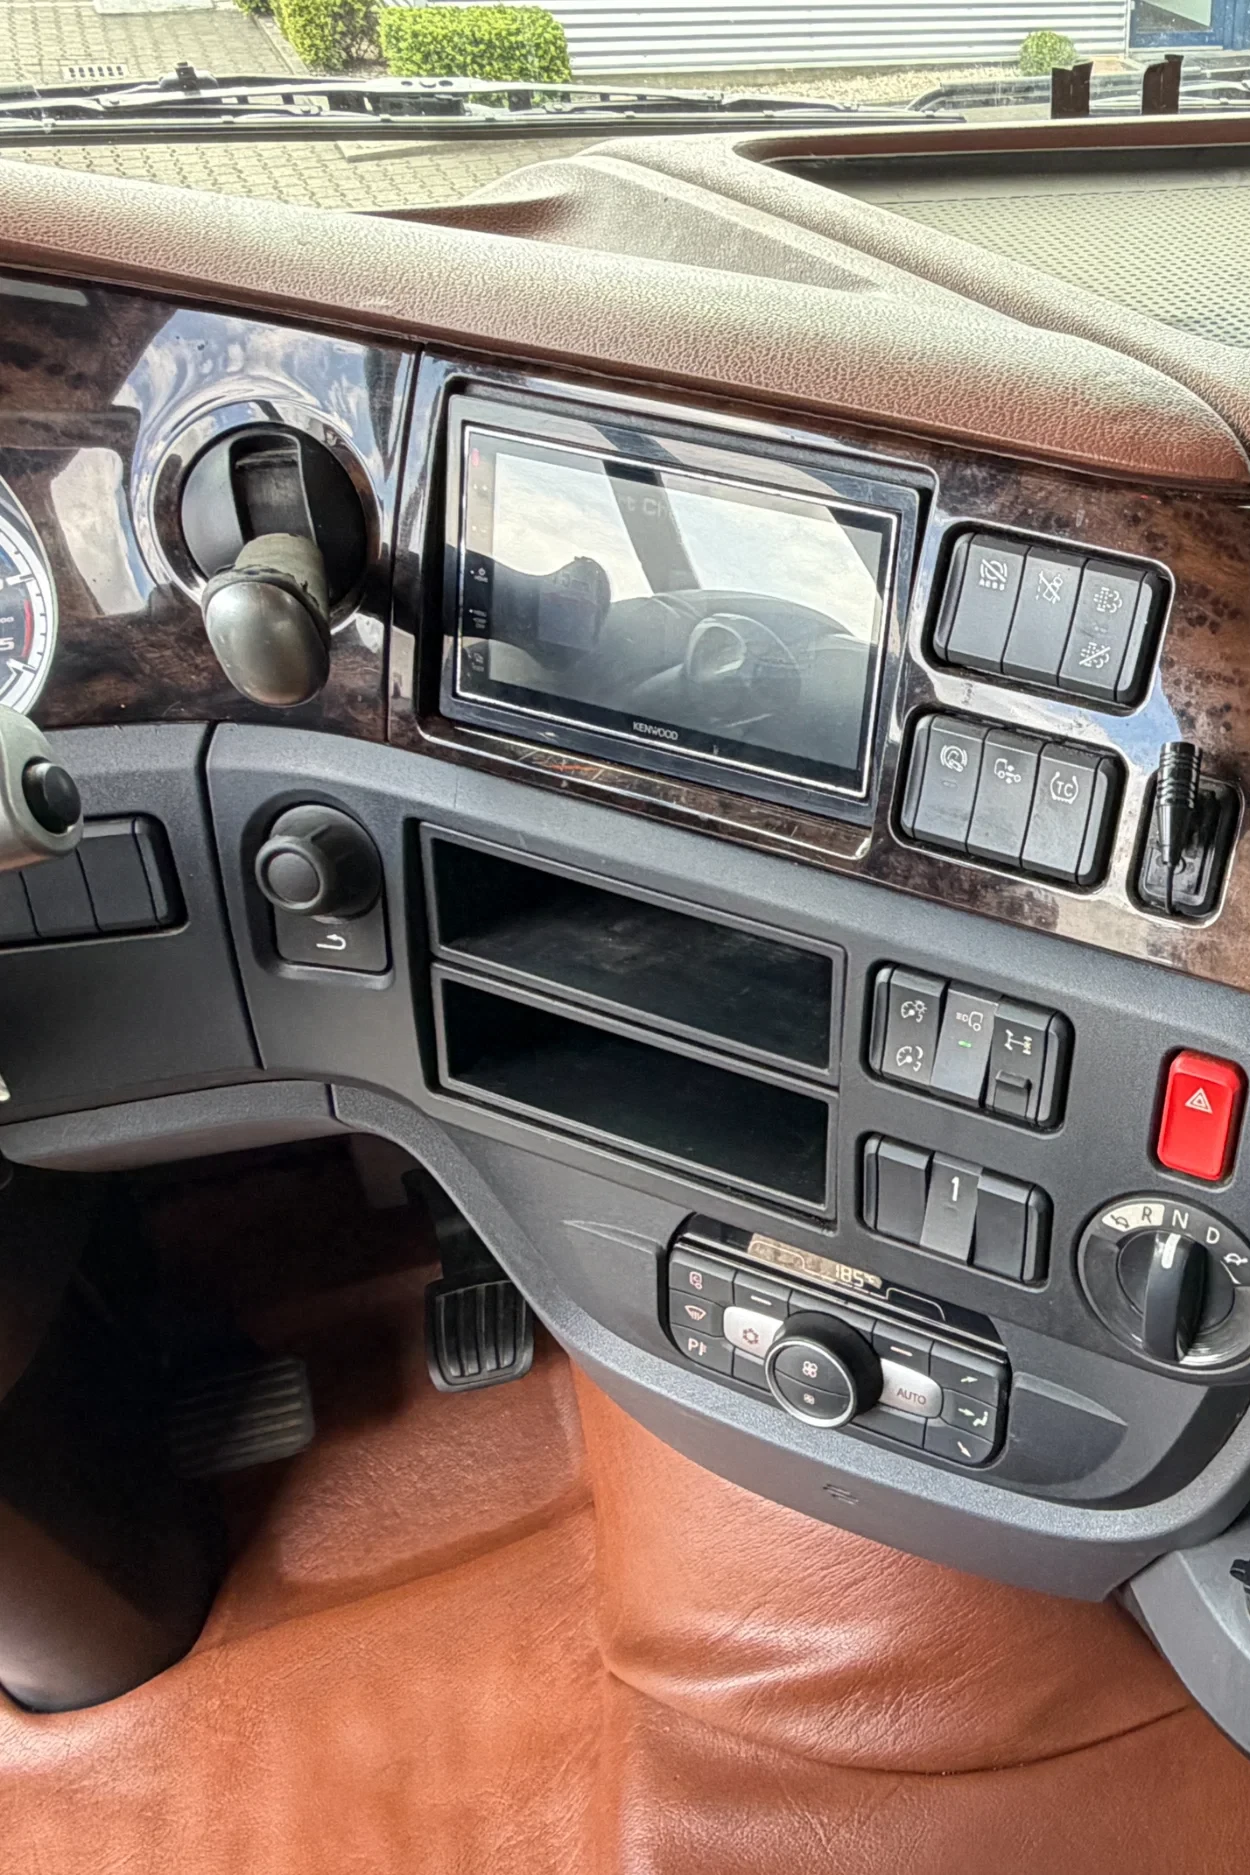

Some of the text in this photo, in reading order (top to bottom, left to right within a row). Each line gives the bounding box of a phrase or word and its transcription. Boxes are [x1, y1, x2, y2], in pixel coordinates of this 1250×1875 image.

[632, 721, 679, 740] KENWOOD
[1056, 780, 1074, 797] TC
[951, 1176, 959, 1201] 1
[1141, 1205, 1220, 1244] R N D
[896, 1387, 927, 1406] AUTO
